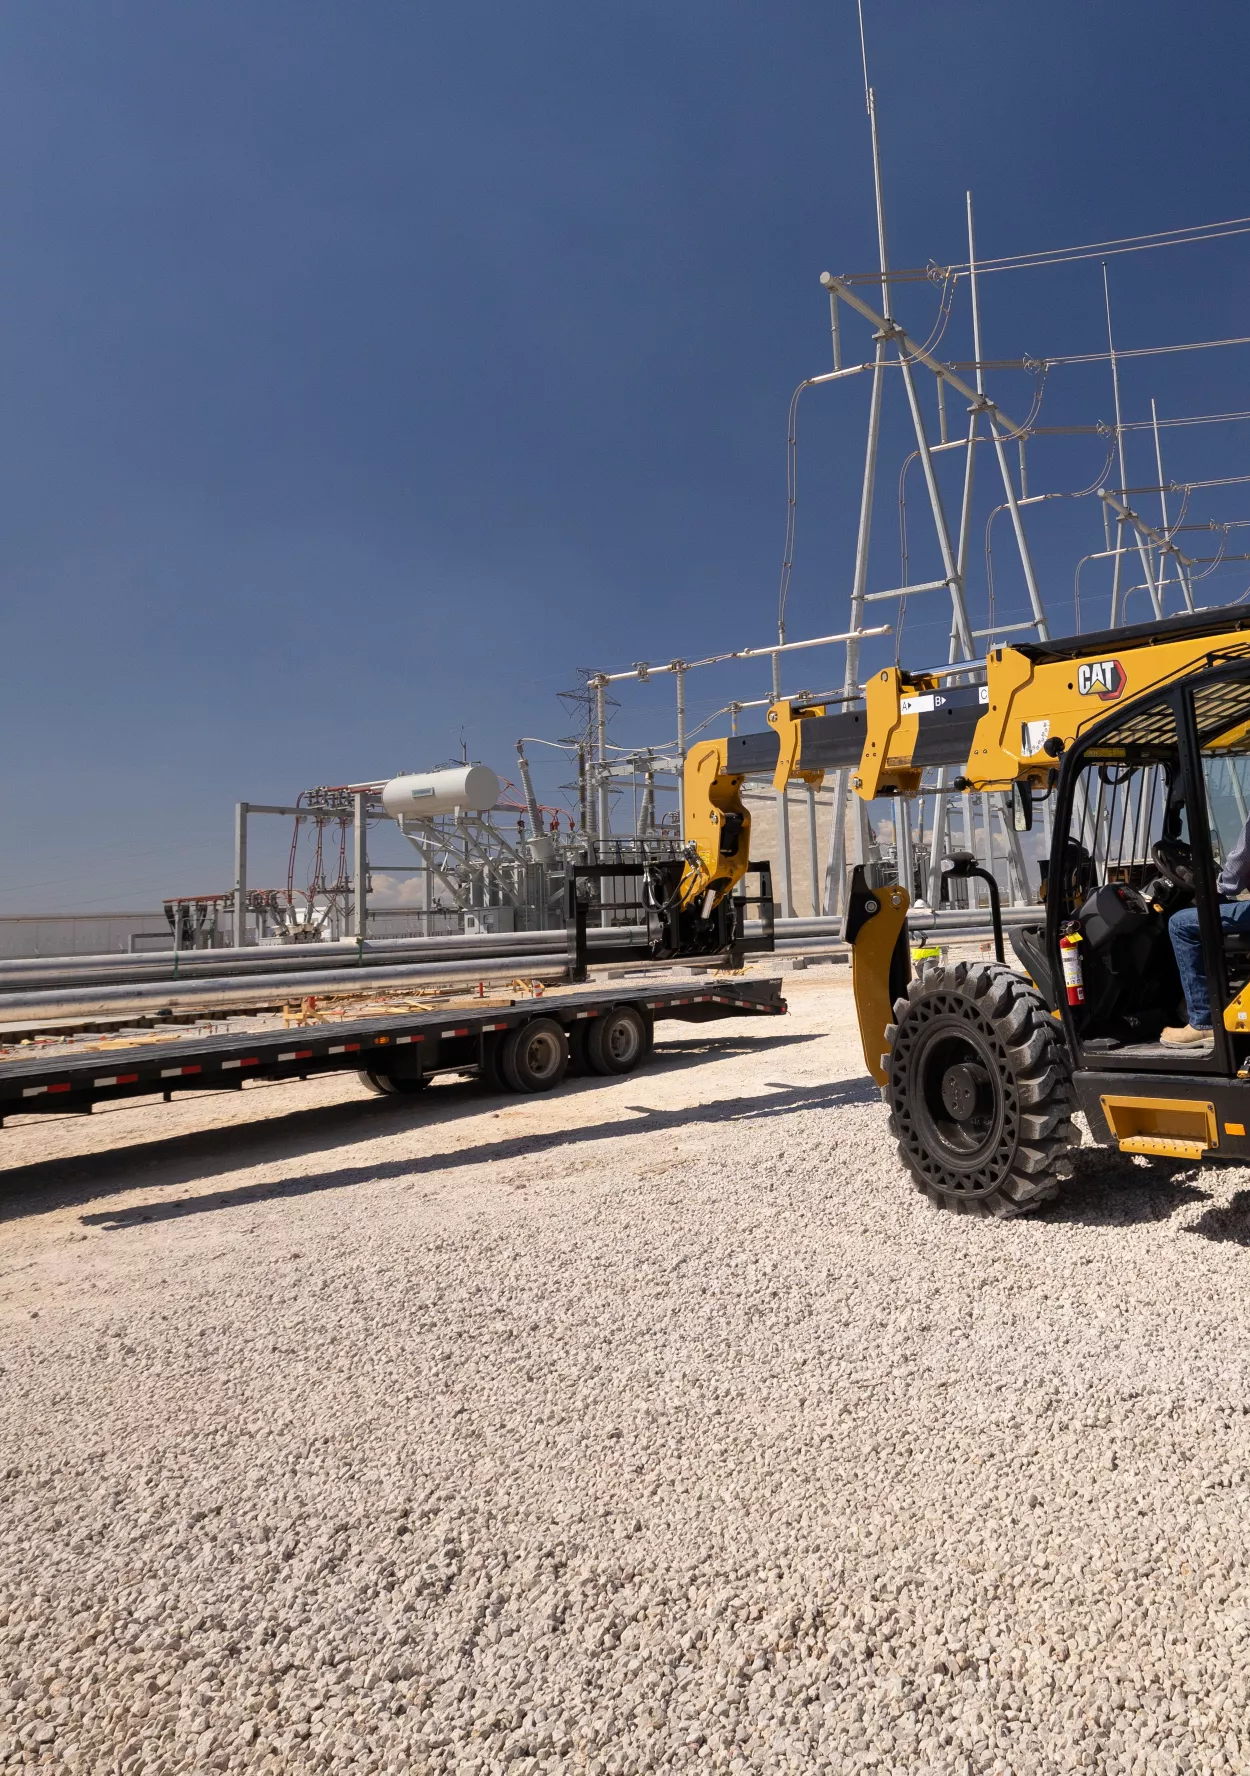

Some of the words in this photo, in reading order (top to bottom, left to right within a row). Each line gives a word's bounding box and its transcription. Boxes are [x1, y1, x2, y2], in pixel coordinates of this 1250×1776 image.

[1078, 661, 1114, 695] CAT
[935, 695, 942, 706] B
[902, 701, 908, 712] A
